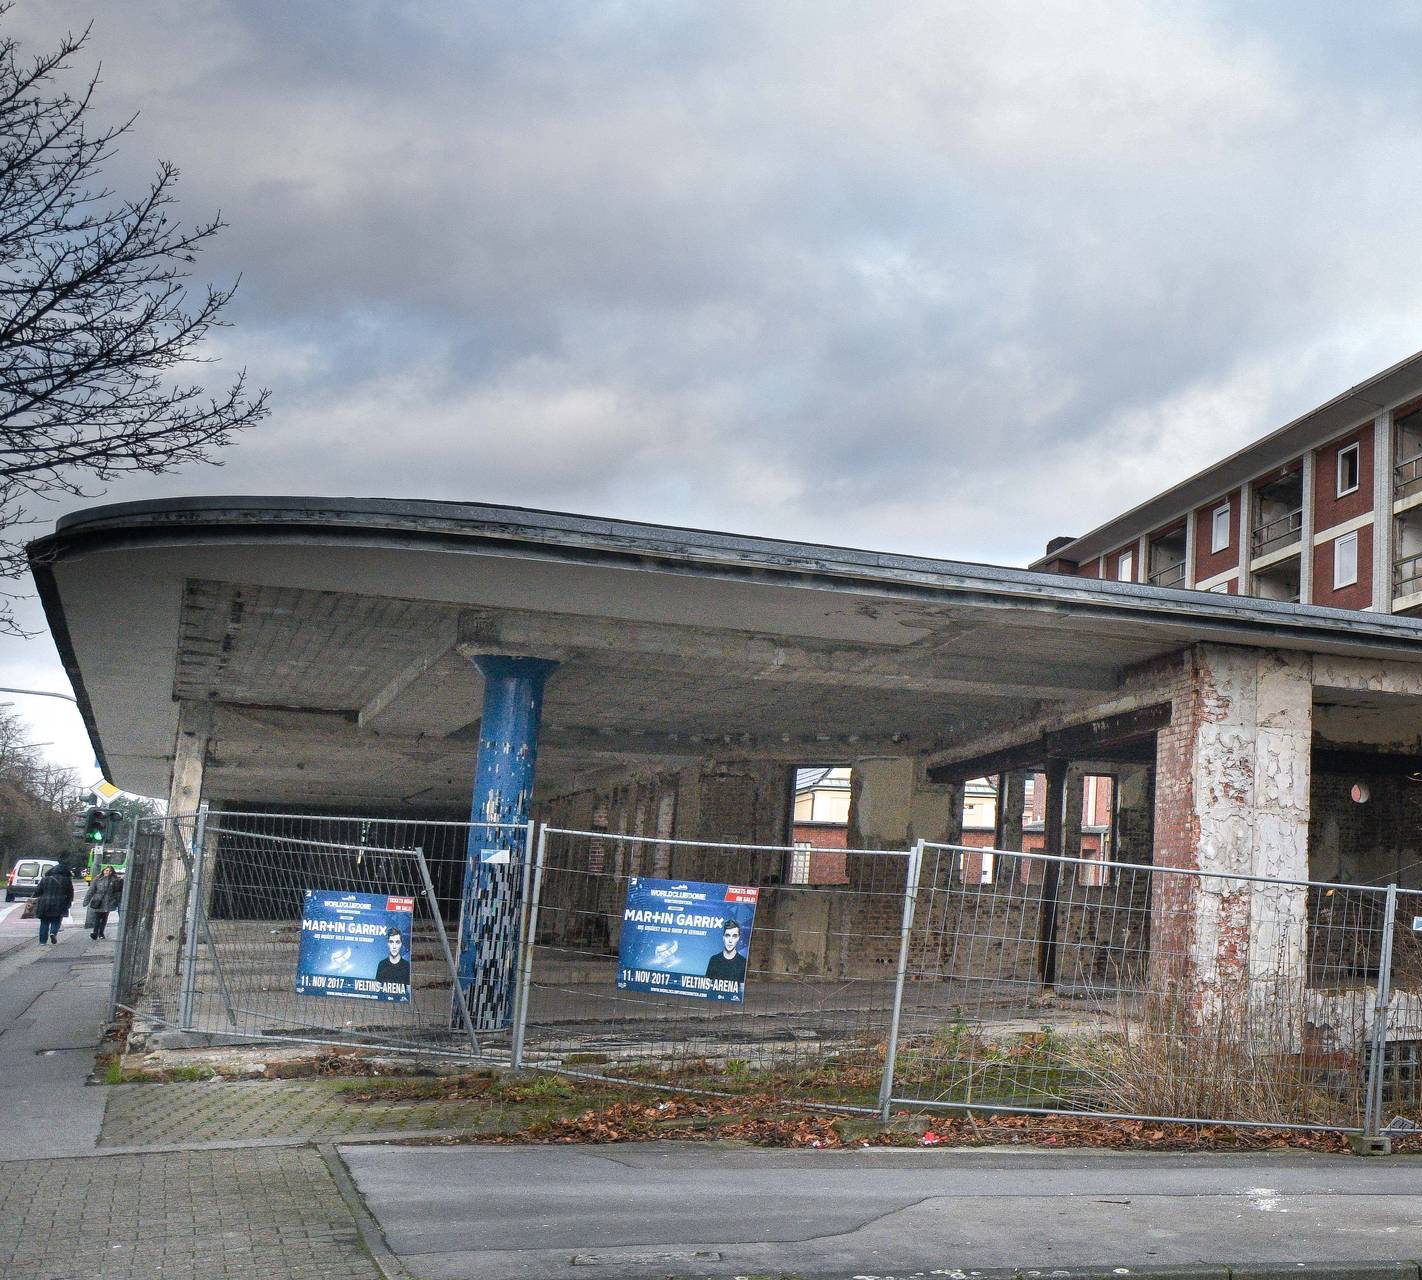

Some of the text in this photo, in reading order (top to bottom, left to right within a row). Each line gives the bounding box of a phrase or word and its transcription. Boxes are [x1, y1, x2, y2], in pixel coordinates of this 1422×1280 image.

[348, 922, 387, 936] GARRIX
[676, 914, 724, 929] GARRIX
[301, 975, 311, 987] 11.
[312, 976, 326, 988] NOV
[327, 977, 345, 989] 2017
[354, 979, 406, 994] VELTINS-ARENA
[623, 969, 634, 982] 11.
[635, 970, 649, 983] NOV
[651, 972, 670, 985] 2017
[681, 975, 739, 993] VELTINS-ARENA
